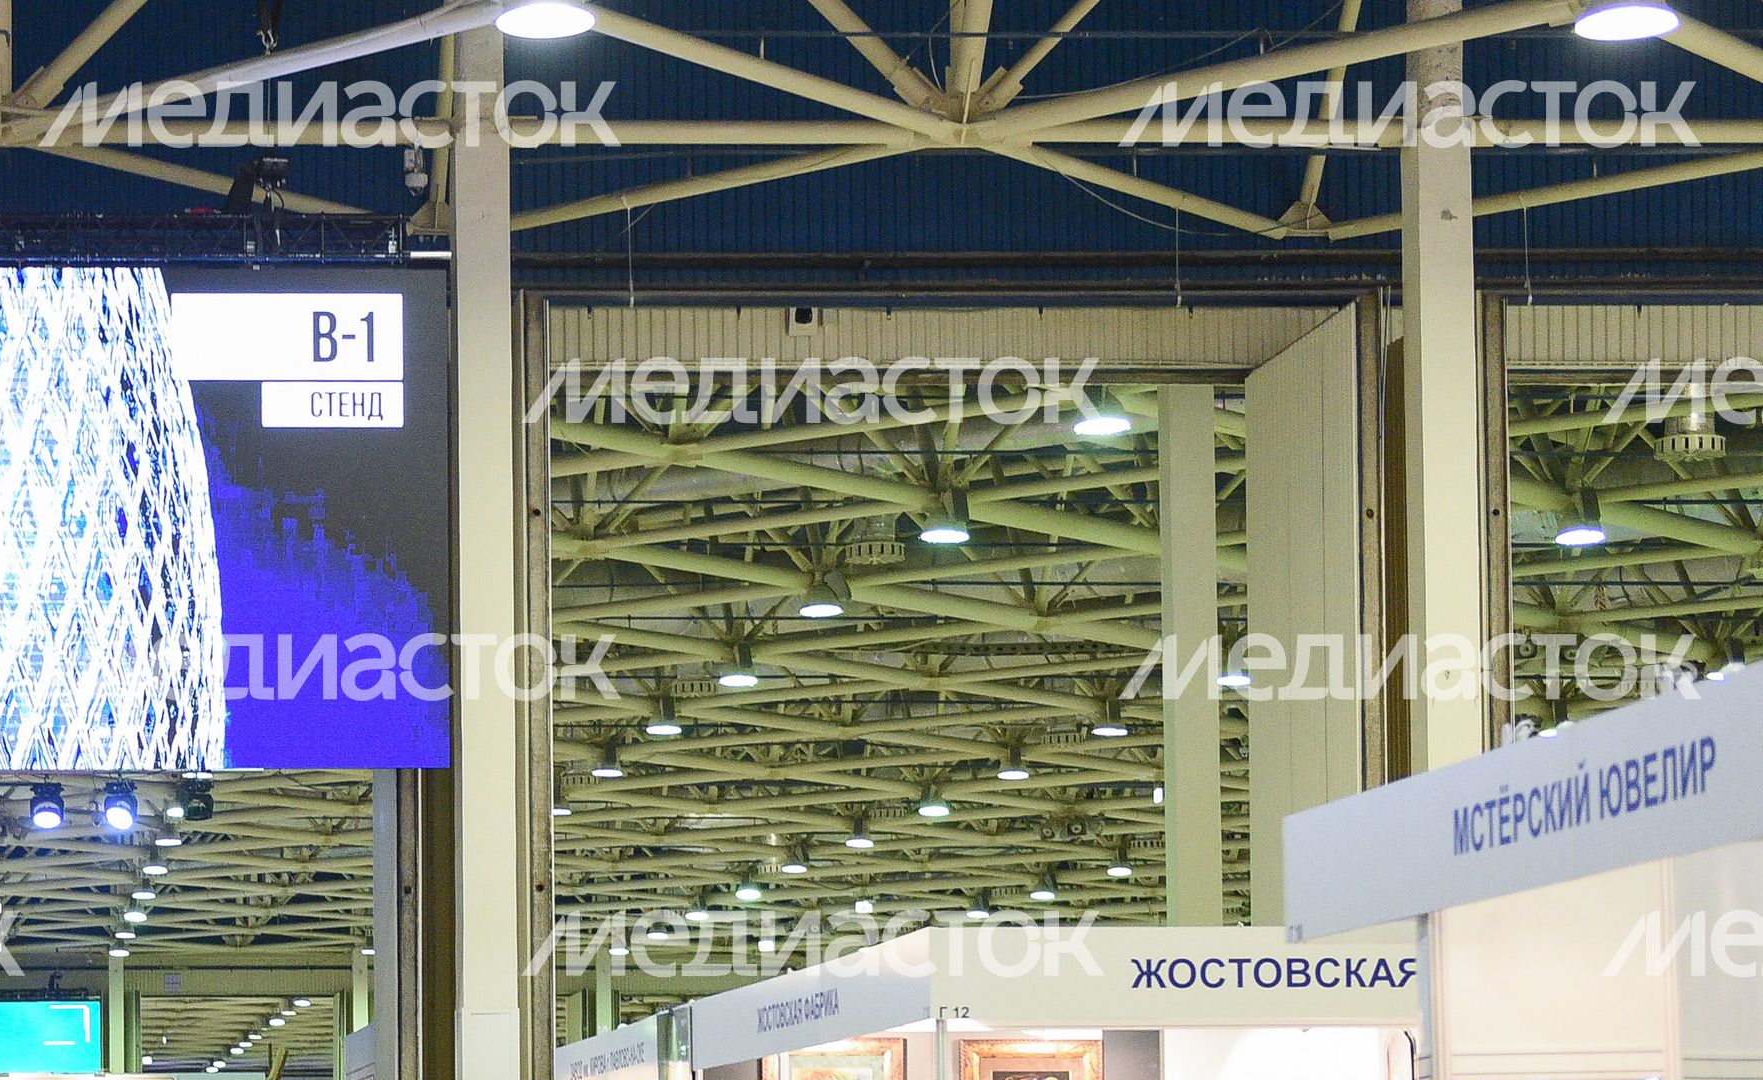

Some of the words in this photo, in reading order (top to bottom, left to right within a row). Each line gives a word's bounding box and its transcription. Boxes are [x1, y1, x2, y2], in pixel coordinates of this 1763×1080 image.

[312, 311, 379, 362] В-1
[310, 390, 383, 423] СТЕНД
[1452, 762, 1591, 856] МСТЁРСКИЙ
[1598, 735, 1717, 822] ЮВЕЛИР
[1130, 957, 1417, 989] ЖОСТОВСКАЯ
[953, 1006, 970, 1018] 12
